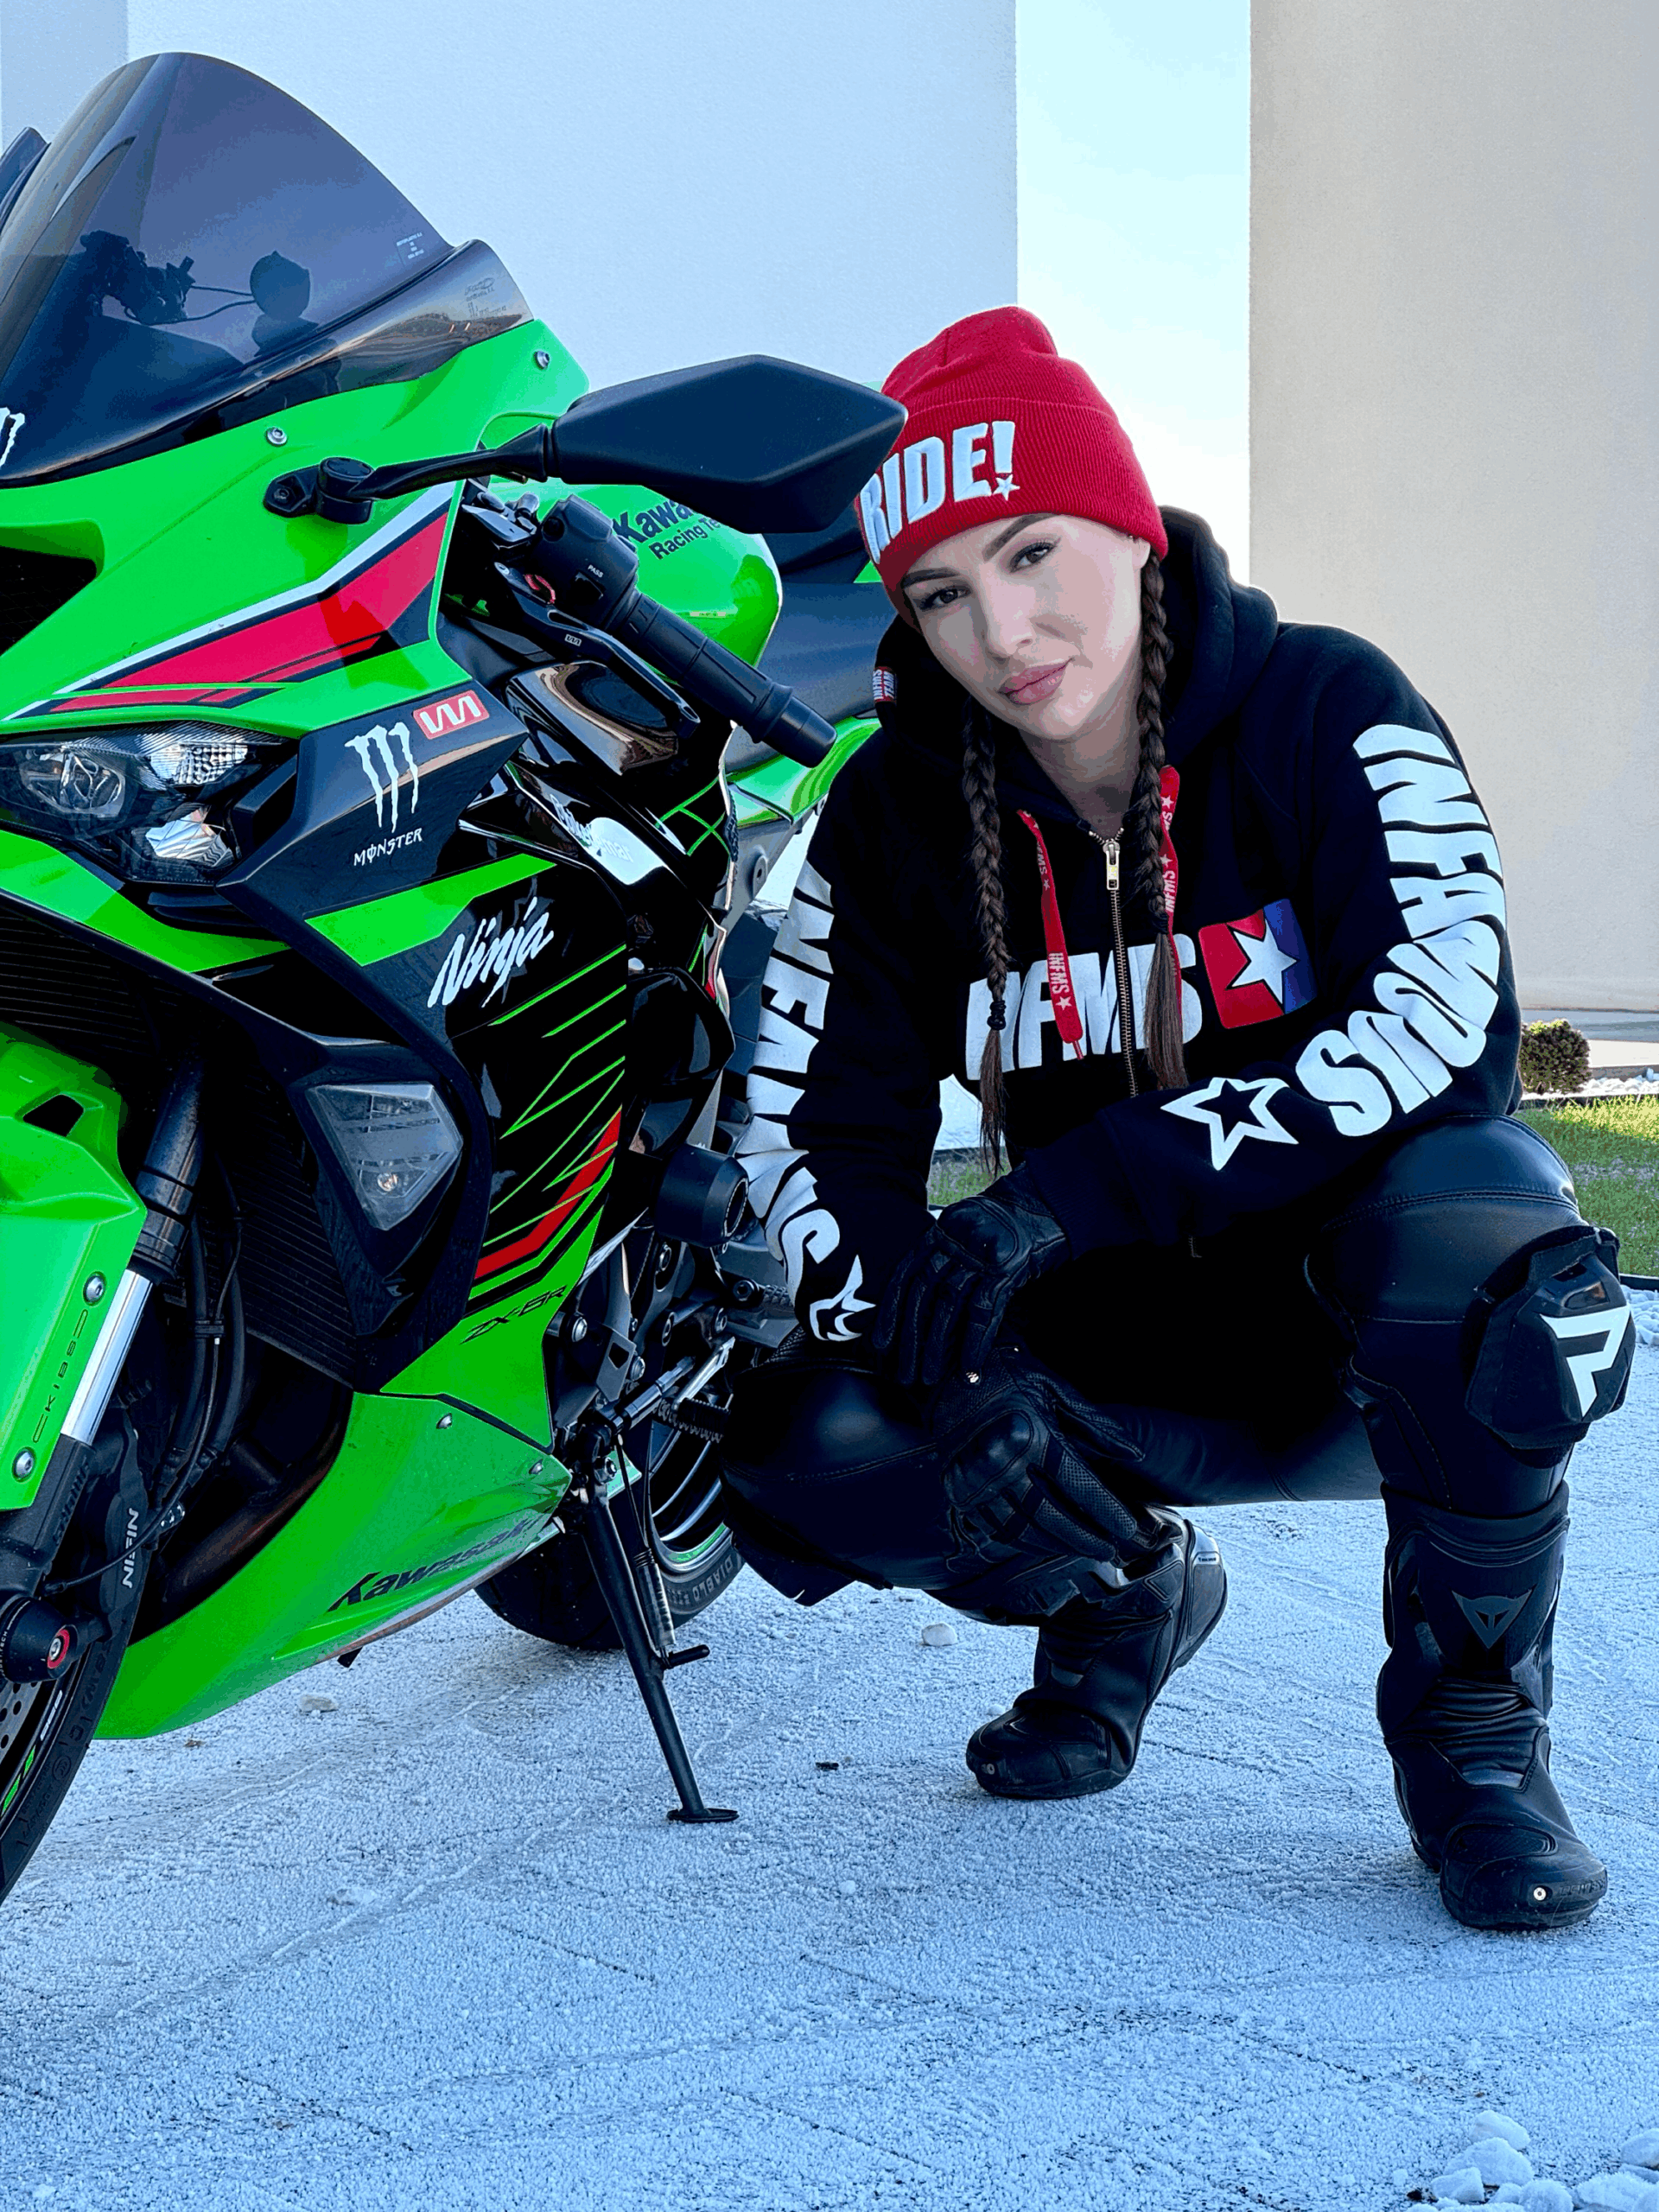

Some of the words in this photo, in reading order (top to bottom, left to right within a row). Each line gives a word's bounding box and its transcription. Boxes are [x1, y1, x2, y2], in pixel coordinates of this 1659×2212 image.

[860, 420, 1020, 564] RIDE!
[588, 564, 604, 578] PASS
[649, 525, 709, 560] Racing
[427, 896, 554, 1008] Ninja
[1295, 723, 1506, 1137] INFAMOUS
[1047, 952, 1071, 995] INFMS
[459, 1285, 567, 1345] ZX-6R
[326, 1504, 555, 1613] Kawasaki
[692, 1554, 734, 1602] DIABLO
